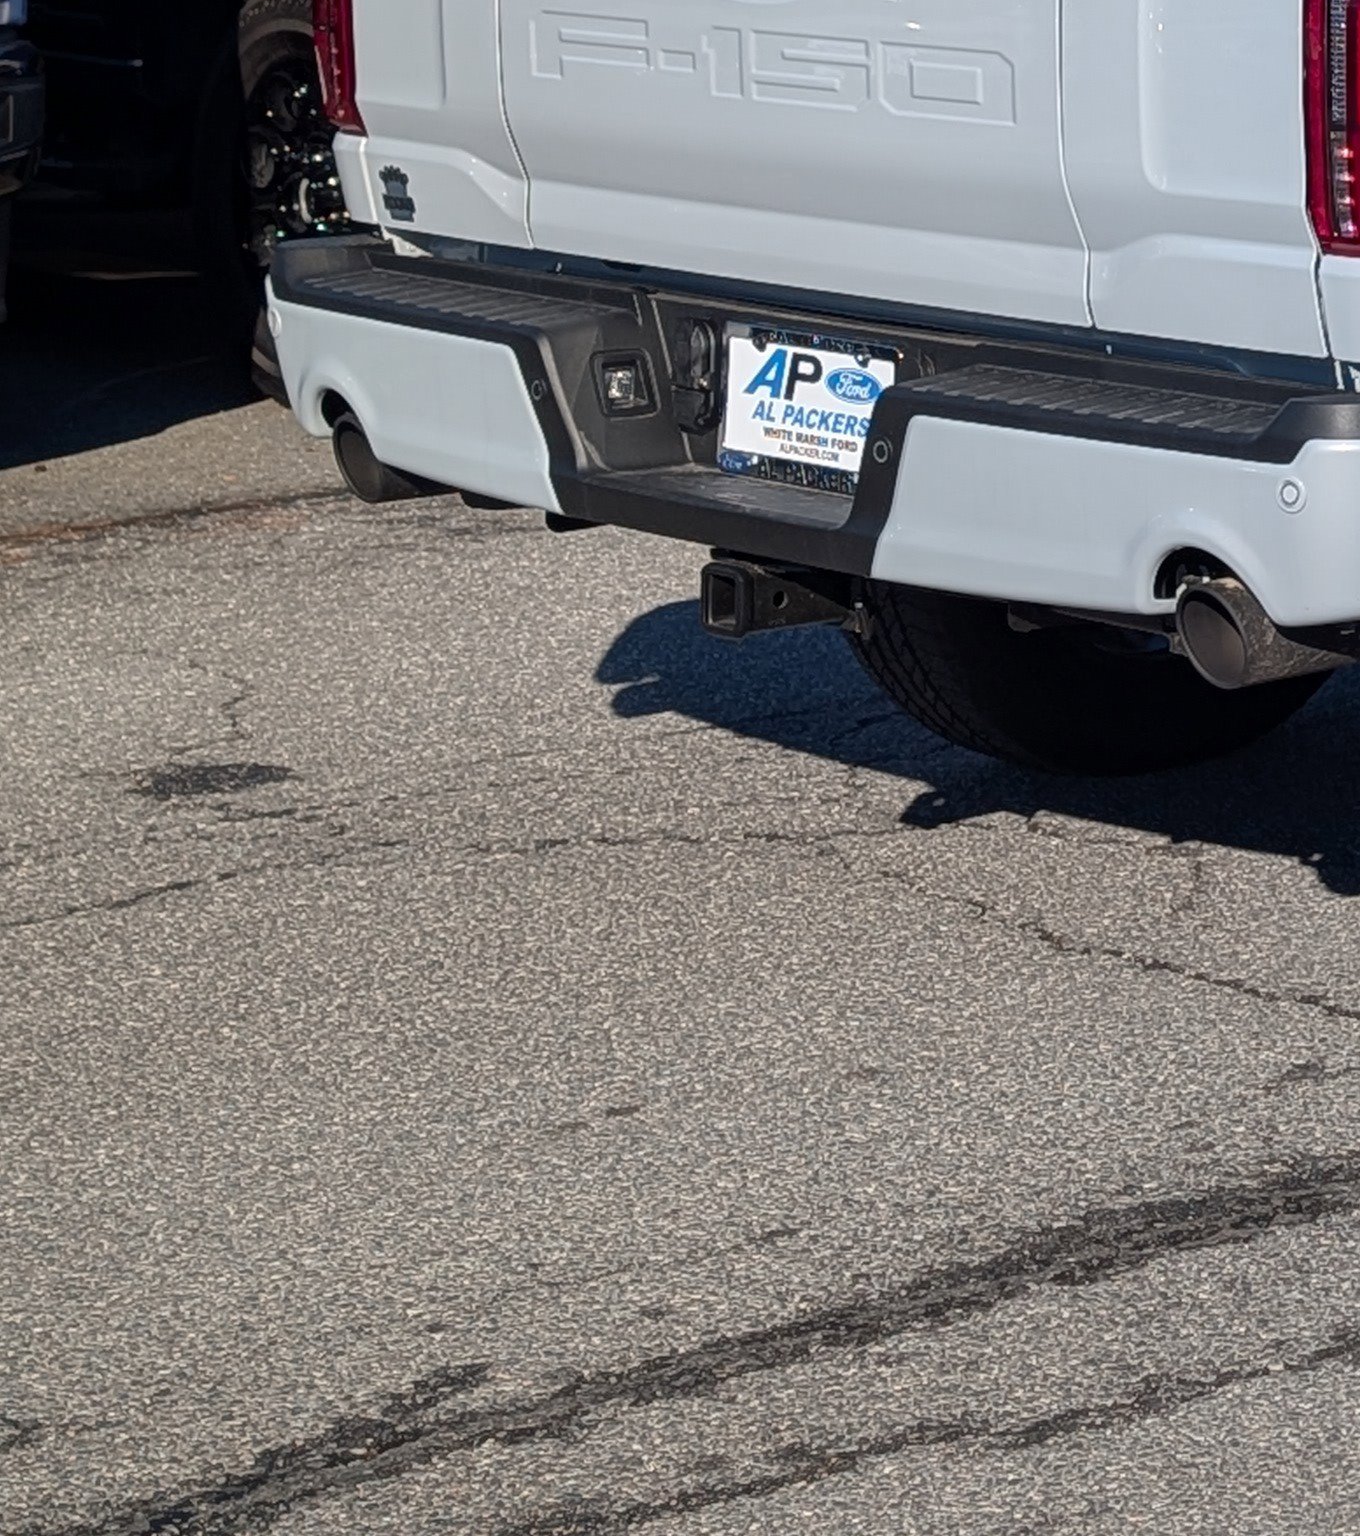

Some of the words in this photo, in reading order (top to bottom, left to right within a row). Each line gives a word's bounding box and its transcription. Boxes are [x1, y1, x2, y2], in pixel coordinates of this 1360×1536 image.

[529, 10, 1017, 126] F-150
[743, 348, 824, 401] AP
[835, 372, 872, 399] Ford
[752, 399, 776, 424] AL
[781, 404, 872, 438] PACKERS
[763, 426, 794, 442] WHITE
[795, 430, 829, 447] MARSH
[830, 437, 858, 452] FORD
